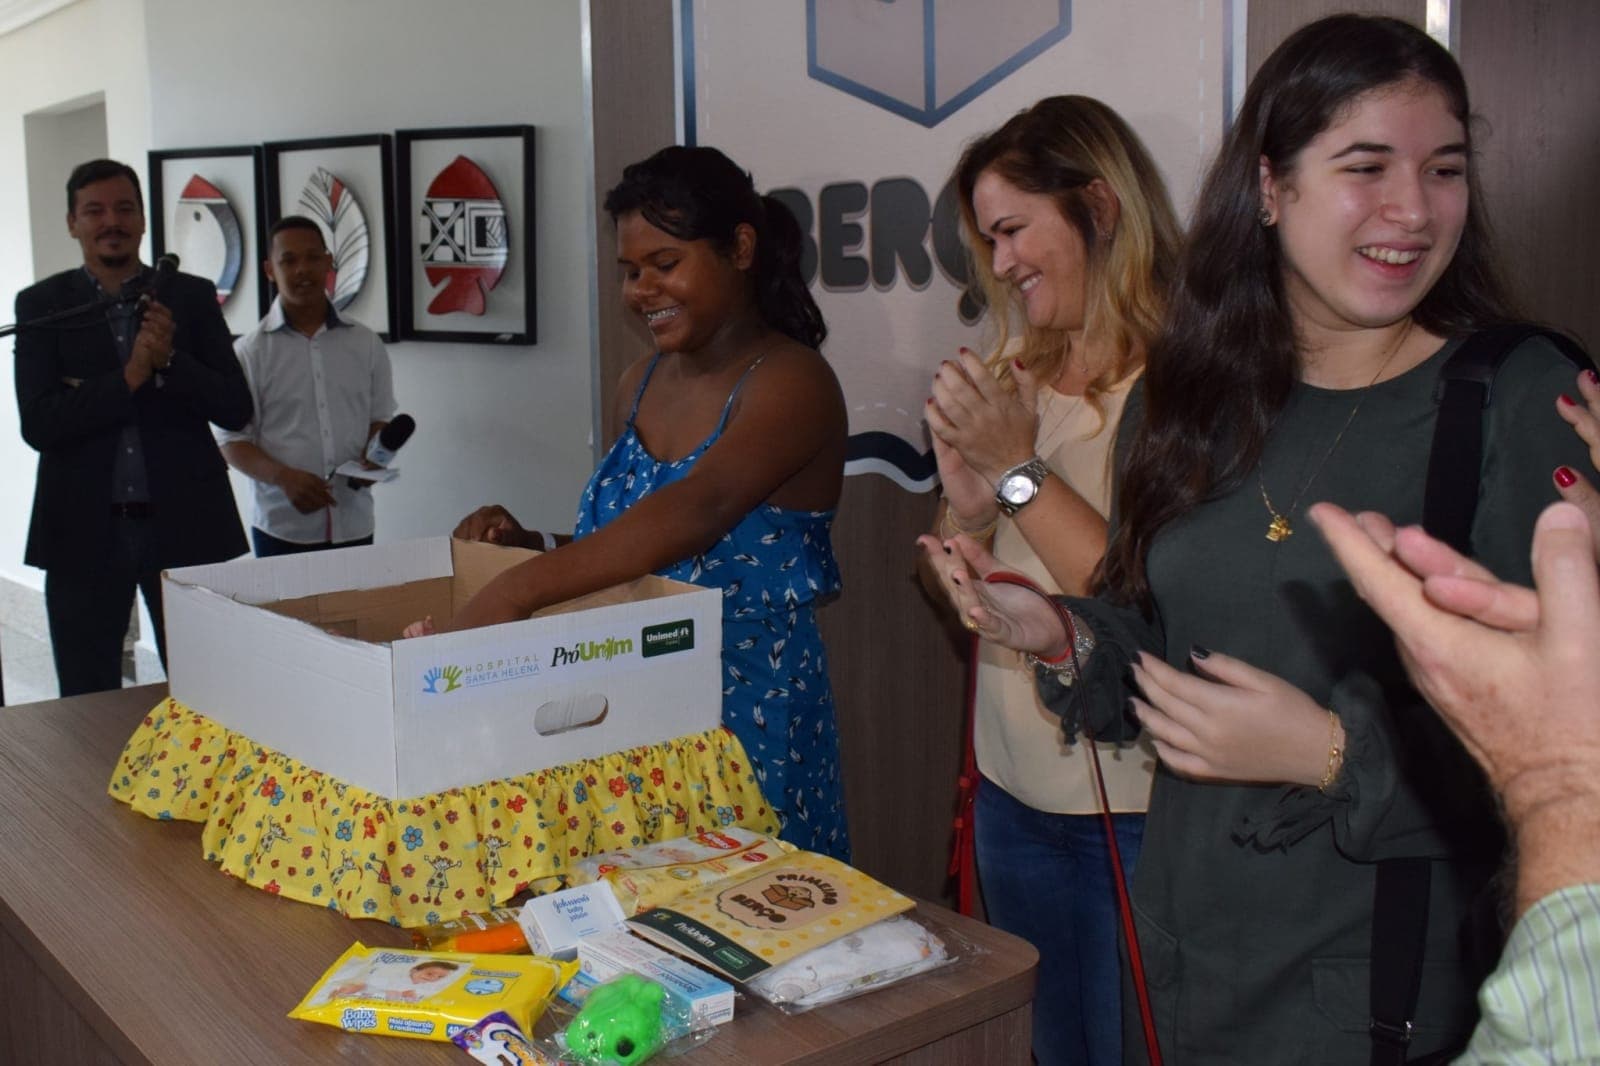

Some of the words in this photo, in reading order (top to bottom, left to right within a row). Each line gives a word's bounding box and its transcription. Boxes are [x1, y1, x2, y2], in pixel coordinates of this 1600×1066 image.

[646, 629, 679, 642] Unimed
[465, 655, 539, 673] HOSPITAL
[465, 671, 498, 684] SANTA
[501, 664, 539, 678] HELENA
[775, 873, 839, 905] PRIMEIRO
[345, 1009, 375, 1020] Baby
[342, 1018, 377, 1031] Wipes
